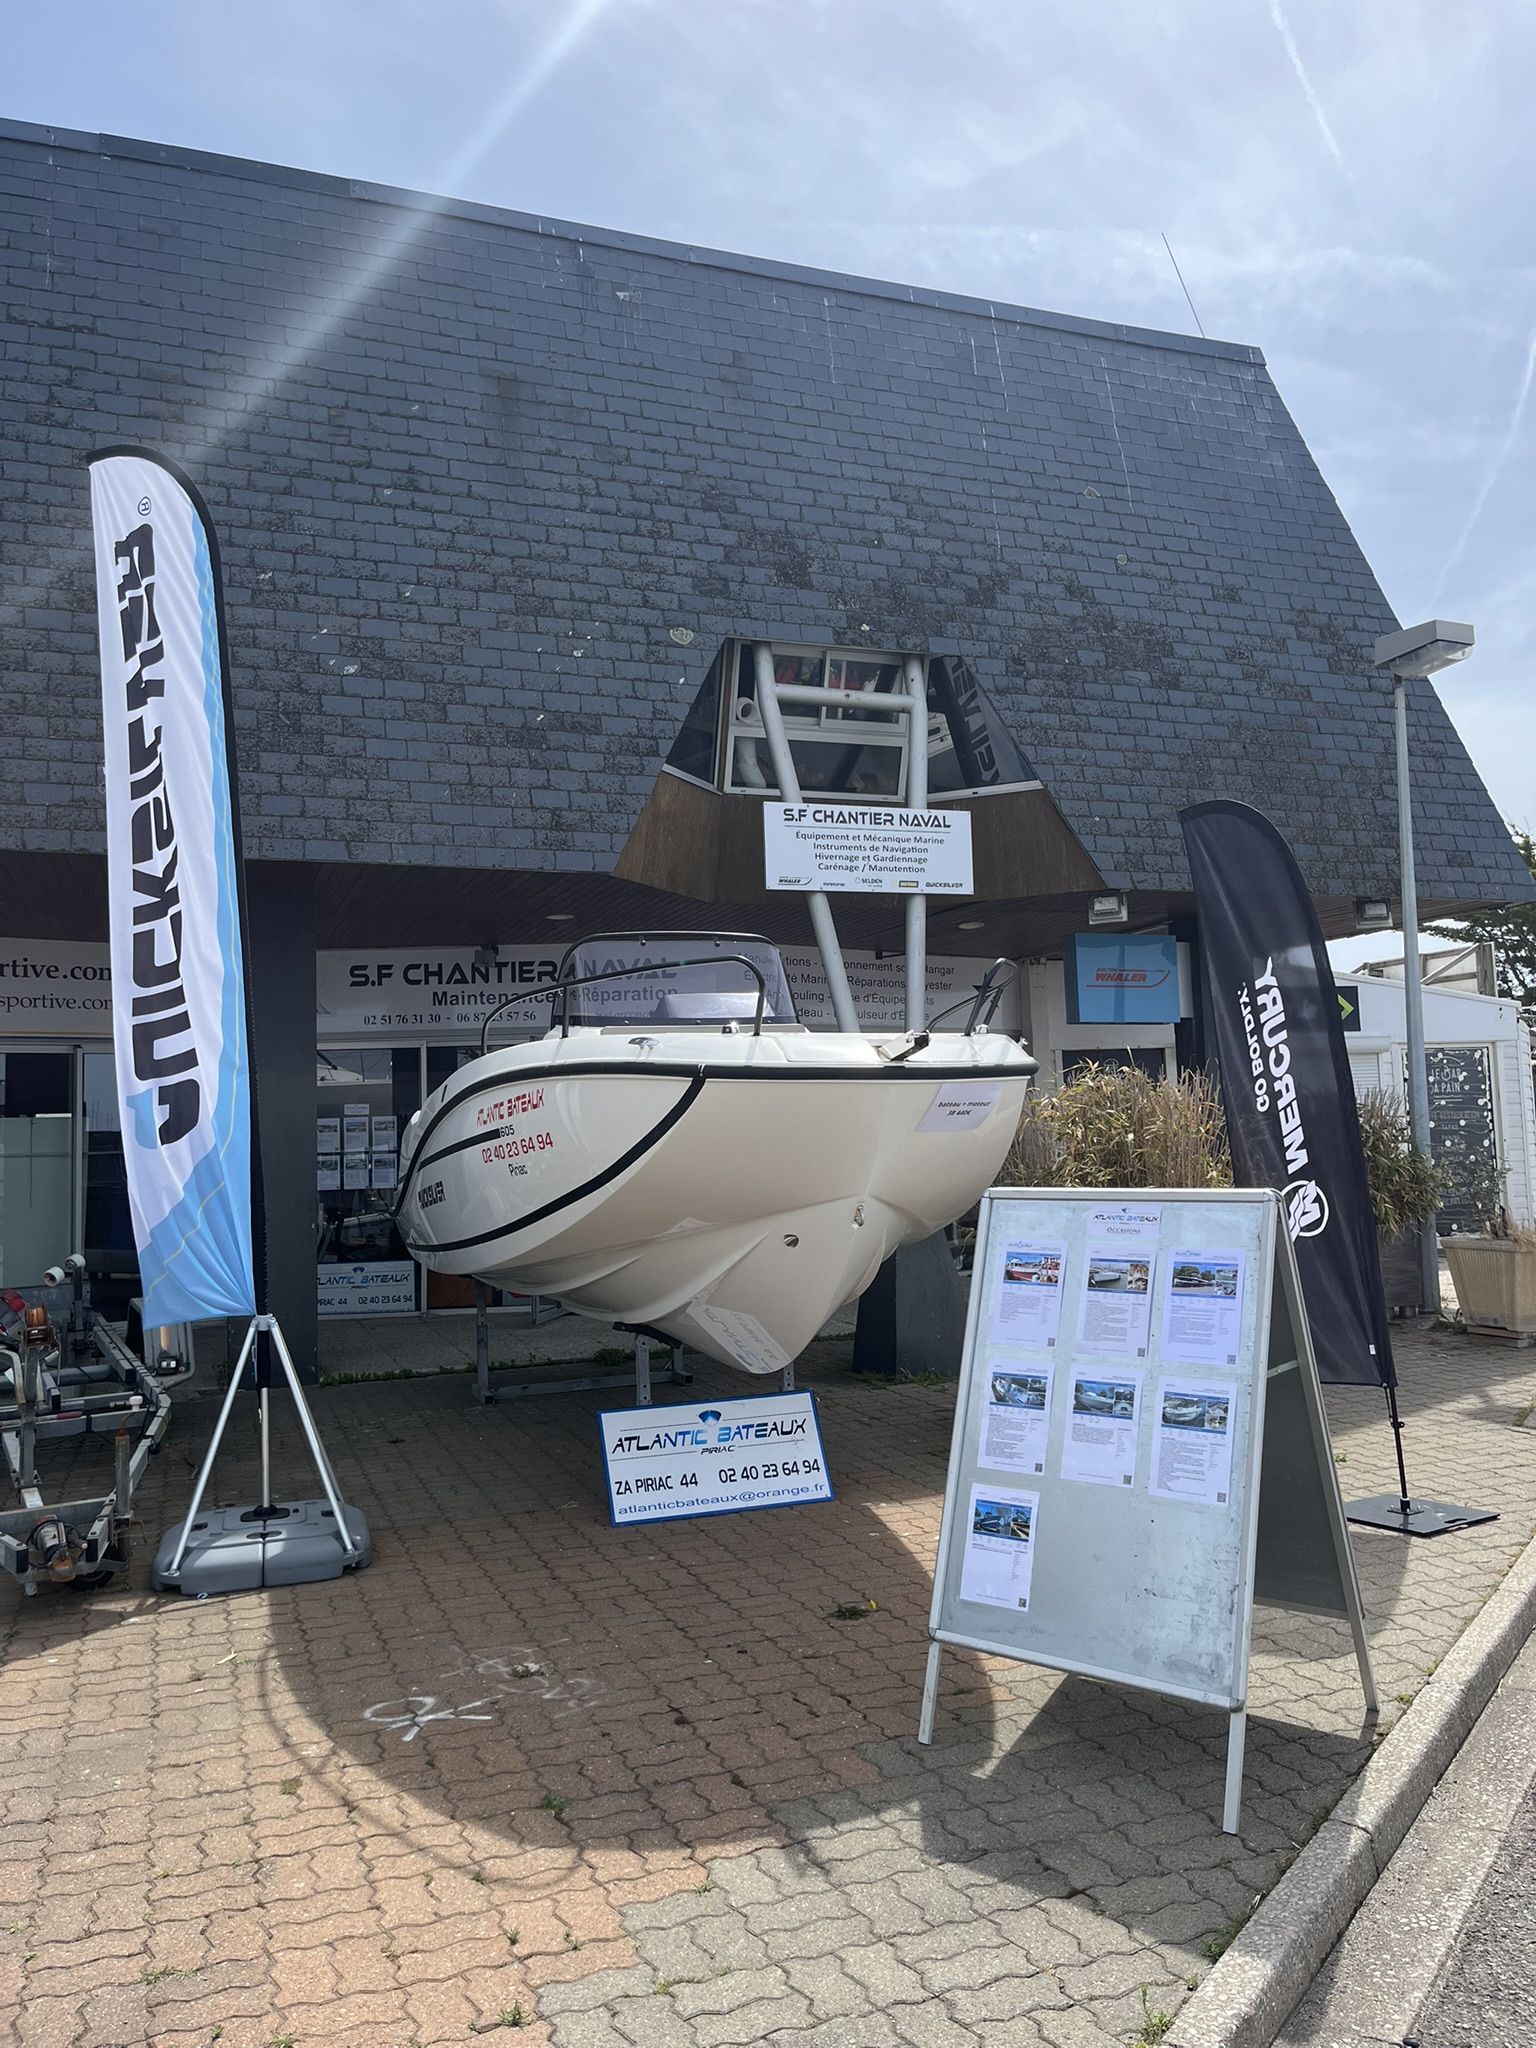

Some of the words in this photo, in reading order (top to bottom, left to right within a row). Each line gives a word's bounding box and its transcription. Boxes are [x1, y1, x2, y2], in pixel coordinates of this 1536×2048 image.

[783, 808, 807, 822] S.F
[812, 809, 895, 826] CHANTIER
[899, 813, 952, 828] NAVAL
[796, 830, 849, 842] Équipement
[863, 834, 912, 844] Mécanique
[913, 836, 945, 845] Marine
[813, 842, 867, 852] Instruments
[869, 844, 880, 852] de
[882, 845, 929, 855] Navigation
[815, 852, 859, 863] Hivernage
[862, 854, 871, 862] et
[873, 855, 928, 865] Gardiennage
[818, 862, 860, 873] Carénage
[868, 864, 926, 873] Manutention
[349, 964, 395, 988] S.F
[403, 960, 560, 985] CHANTIER
[584, 957, 677, 980] NAVAL
[926, 965, 955, 976] angar
[847, 976, 906, 988] Réparations
[924, 981, 952, 991] yester
[1095, 973, 1148, 983] WHALER
[363, 1015, 377, 1026] 02
[381, 1015, 392, 1025] 51
[396, 1014, 408, 1025] 76
[412, 1014, 423, 1024] 31
[427, 1013, 441, 1024] 30
[456, 1012, 470, 1023] 06
[473, 1012, 486, 1022] 87
[507, 1011, 520, 1021] 57
[523, 1010, 536, 1021] 56
[1441, 1082, 1461, 1093] PAIN
[477, 1101, 504, 1127] ATLANTIC
[507, 1088, 545, 1118] BATEAUX
[500, 1124, 515, 1138] 605
[482, 1148, 494, 1164] 02
[494, 1145, 505, 1160] 40
[506, 1141, 520, 1159] 23
[520, 1137, 535, 1155] 64
[536, 1132, 554, 1150] 94
[508, 1163, 528, 1177] Piriac
[317, 1276, 356, 1286] LANTIC
[361, 1274, 411, 1285] BATEAUX
[358, 1296, 368, 1305] 02
[370, 1296, 380, 1304] 40
[382, 1295, 390, 1304] 23
[392, 1295, 401, 1303] 64
[403, 1294, 413, 1303] 94
[611, 1429, 708, 1455] ATLANTIC
[717, 1418, 807, 1443] BATEAUX
[701, 1445, 736, 1455] PIRIAC
[615, 1480, 633, 1496] ZA
[635, 1475, 673, 1494] PIRIAC
[680, 1472, 699, 1488] 44
[718, 1468, 738, 1484] 02
[740, 1465, 759, 1481] 40
[762, 1463, 779, 1479] 23
[782, 1461, 800, 1476] 64
[802, 1458, 820, 1474] 94
[618, 1482, 825, 1515] atlanticbateaux@orange.fr
